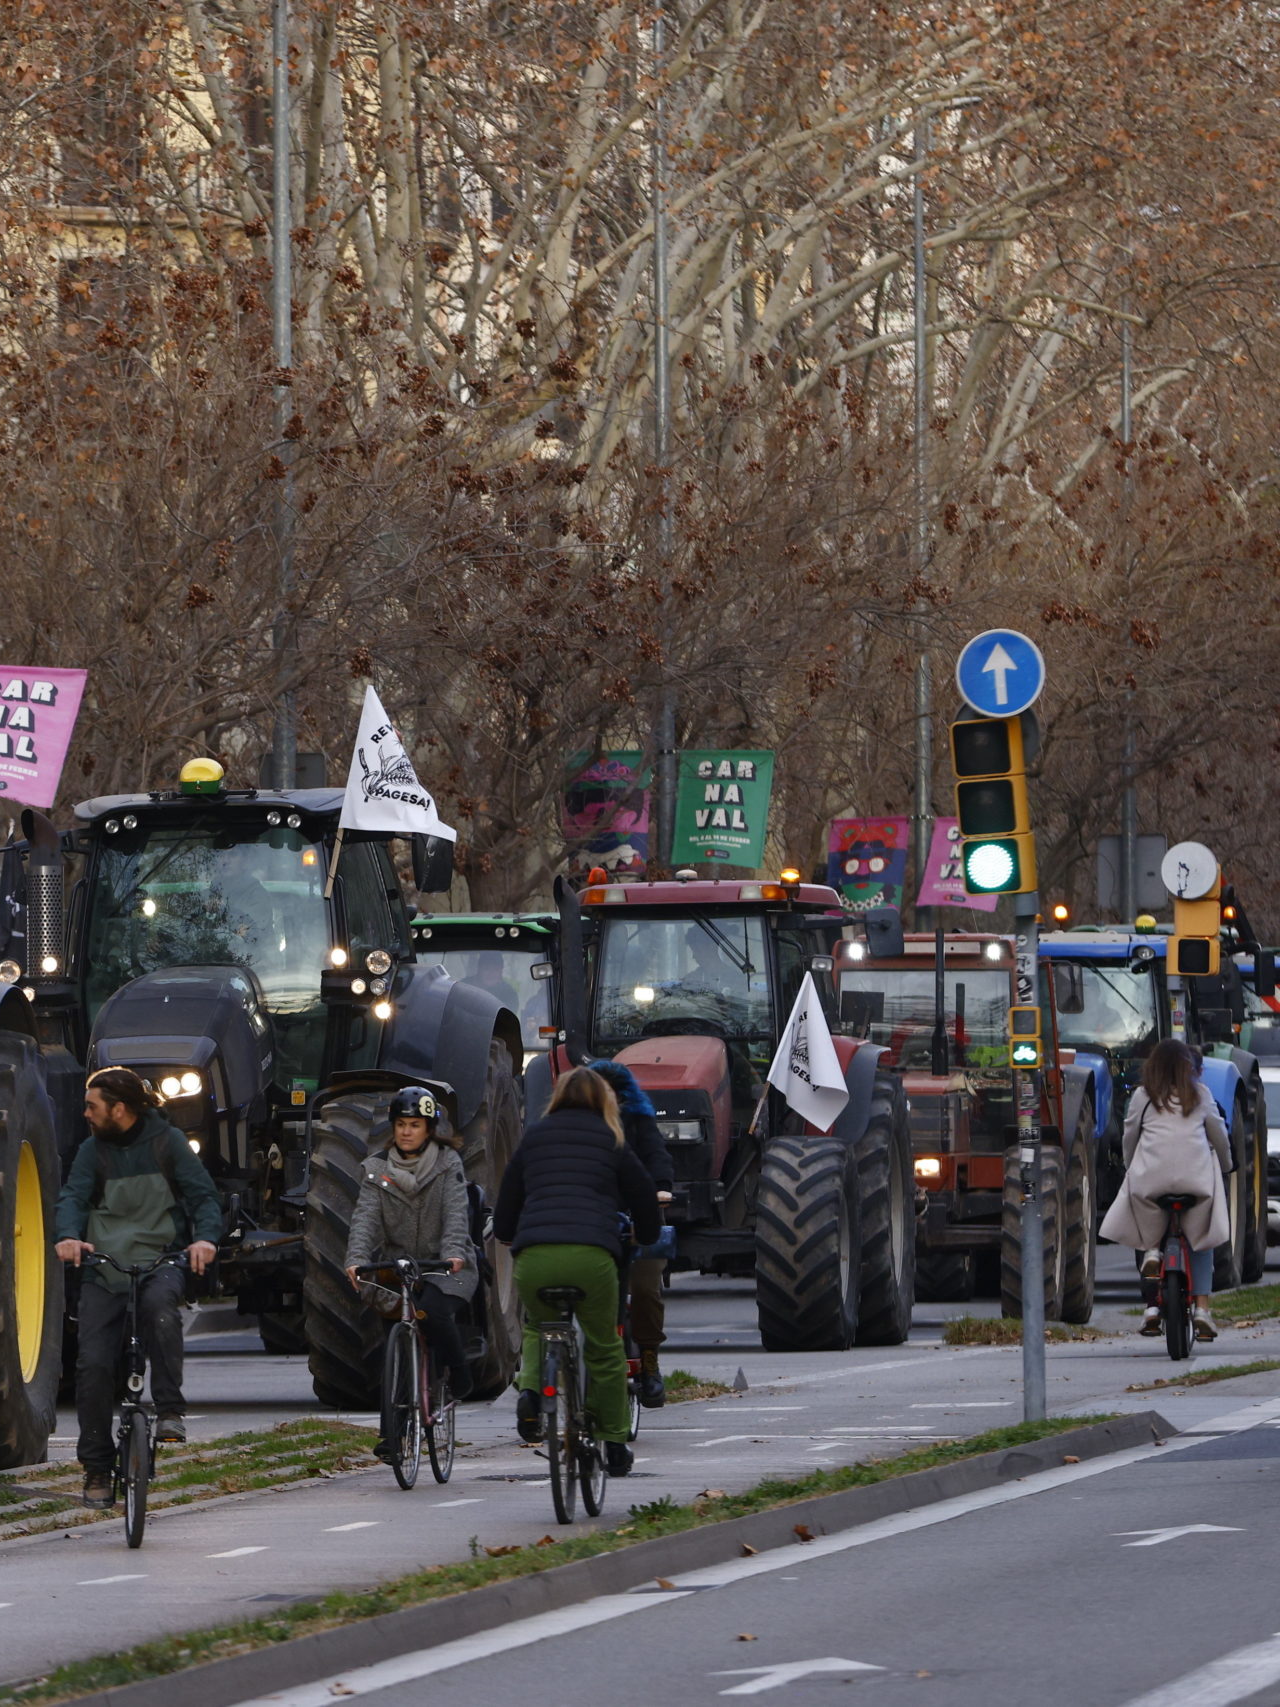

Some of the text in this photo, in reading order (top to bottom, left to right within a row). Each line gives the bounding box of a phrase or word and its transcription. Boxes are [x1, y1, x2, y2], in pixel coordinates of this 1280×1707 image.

[698, 760, 757, 781] CAR
[375, 786, 431, 811] PAGESA!
[704, 783, 744, 806] NA
[695, 808, 749, 832] VAL
[424, 1100, 433, 1114] 8
